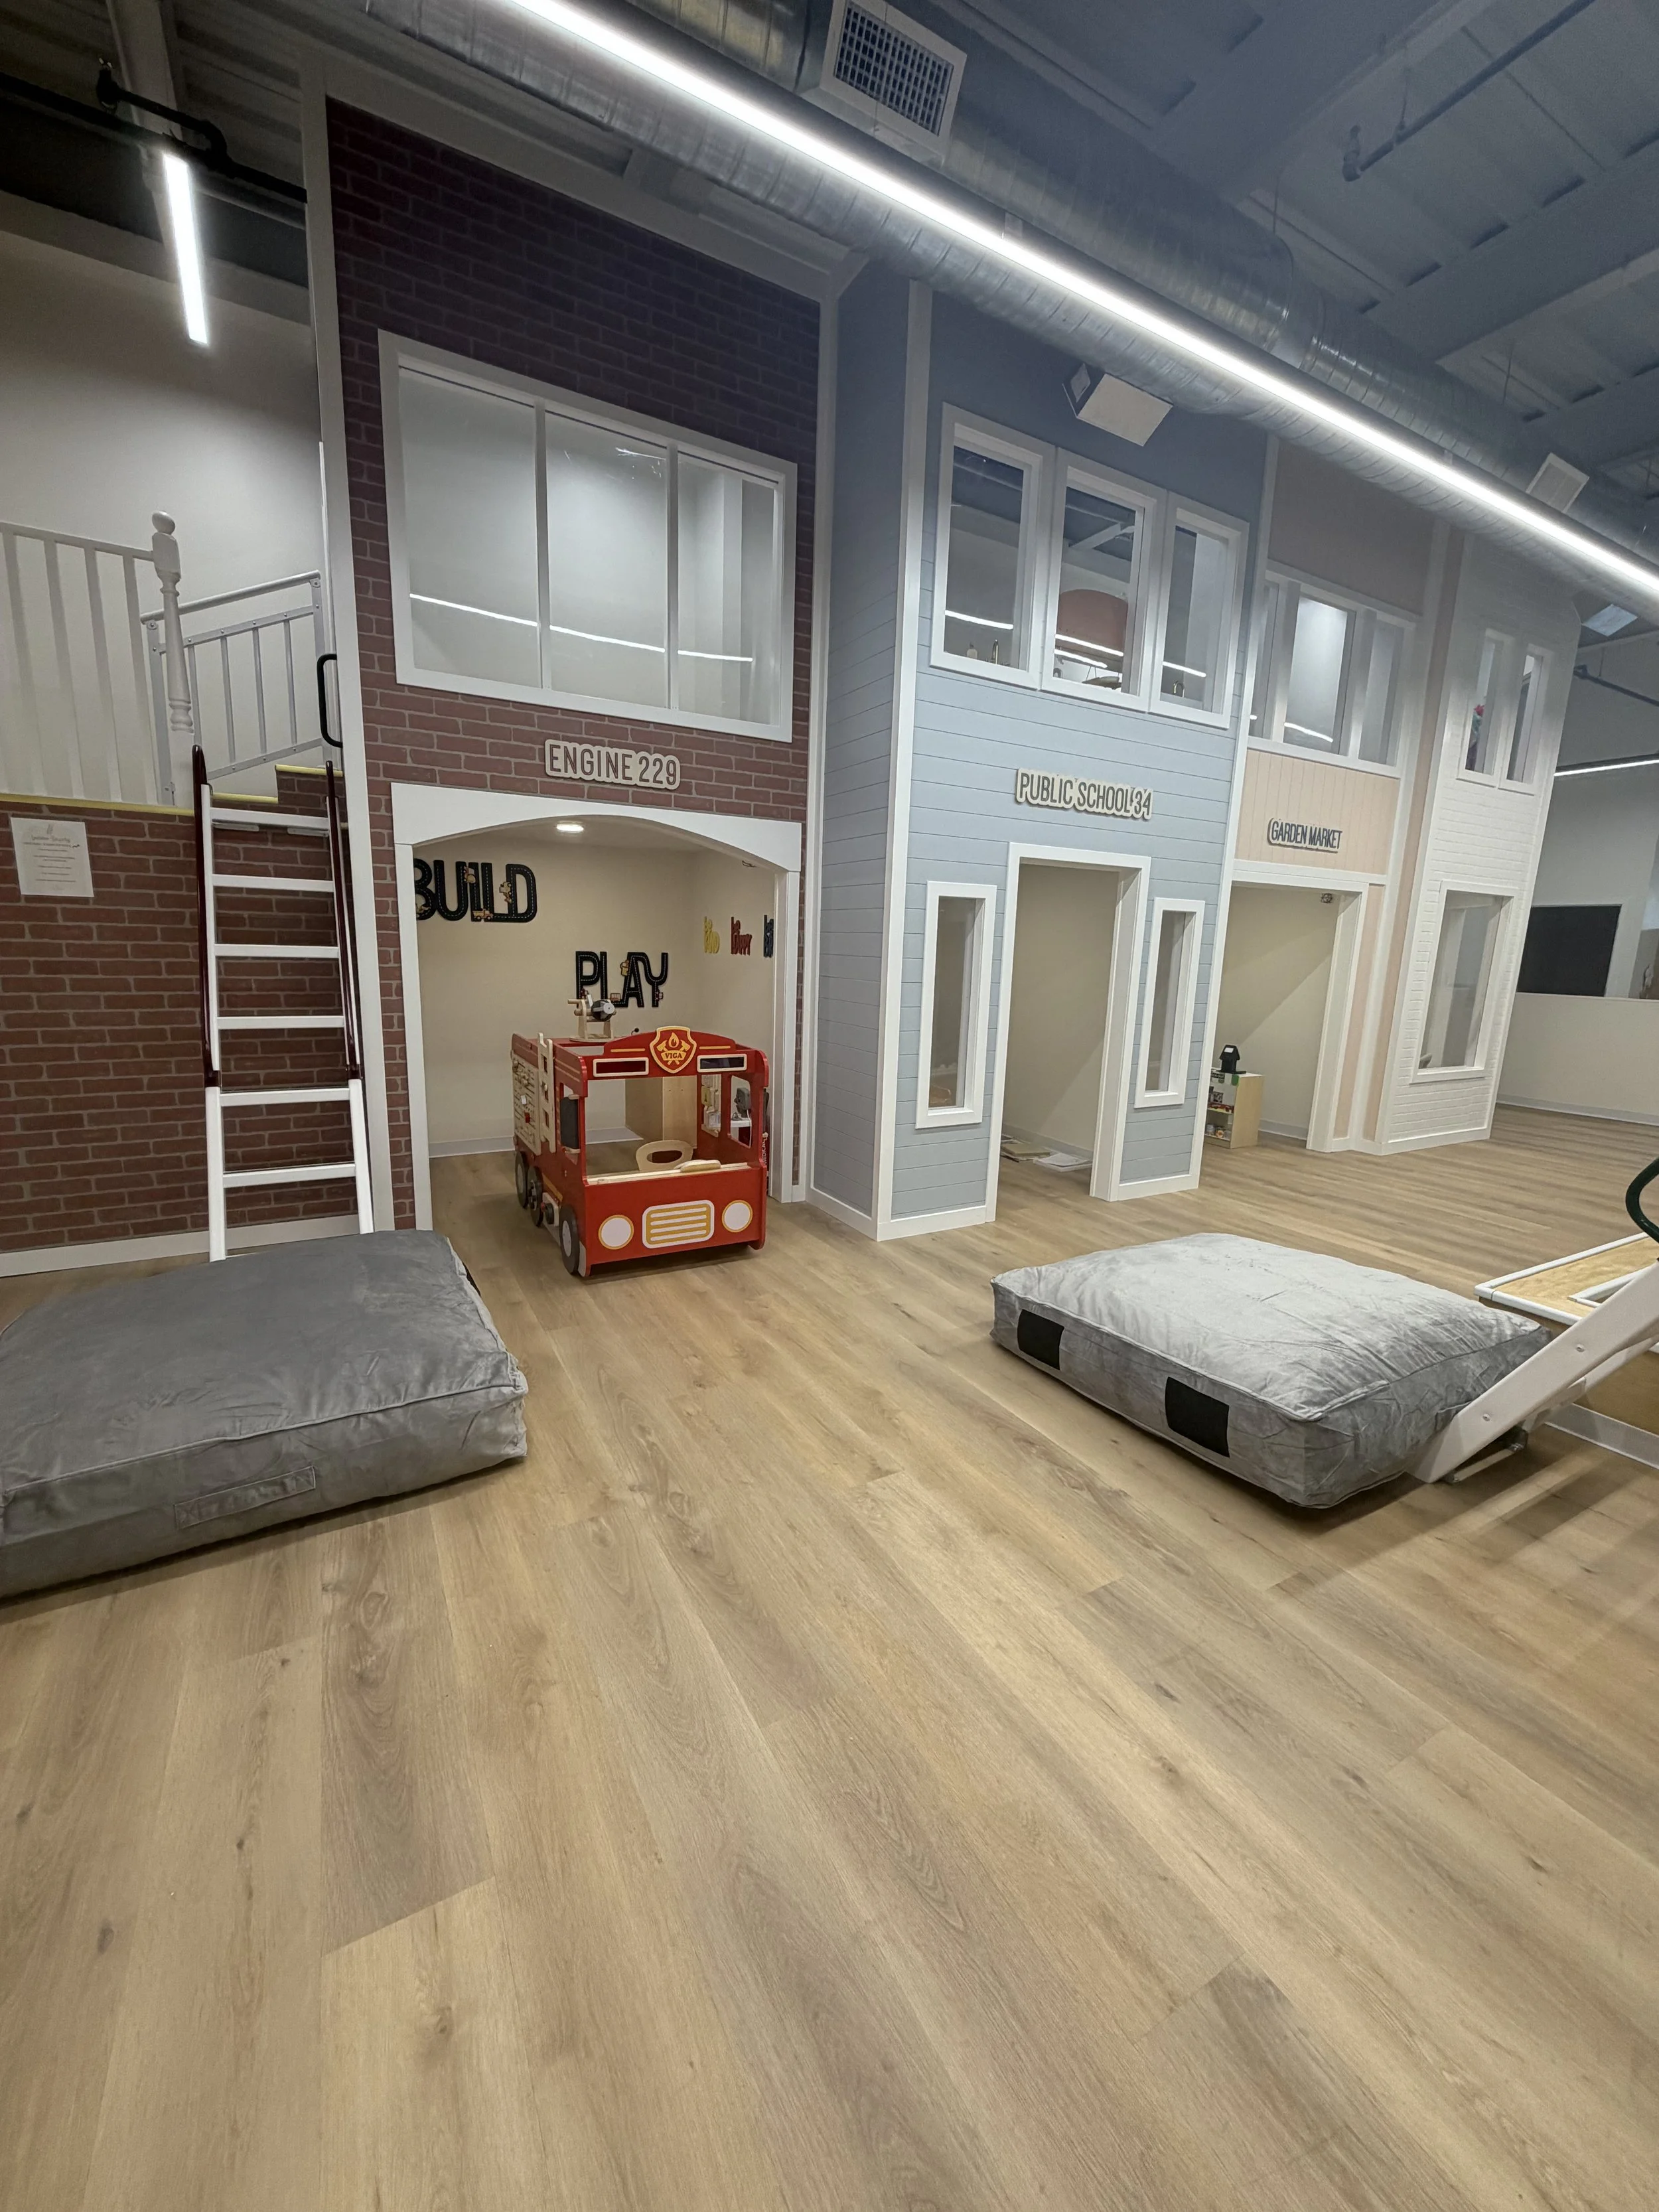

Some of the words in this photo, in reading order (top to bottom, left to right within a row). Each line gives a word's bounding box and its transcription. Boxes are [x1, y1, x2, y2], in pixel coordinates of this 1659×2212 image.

[549, 744, 632, 780] ENGINE
[638, 756, 676, 786] 229
[1019, 773, 1073, 805] PUBLIC
[1077, 782, 1130, 813] SCHOOL
[1134, 790, 1151, 816] 34
[1271, 821, 1307, 844] GARDEN
[1309, 826, 1342, 849] MARKET
[413, 858, 538, 923] BUILD
[575, 951, 668, 1007] PLAY
